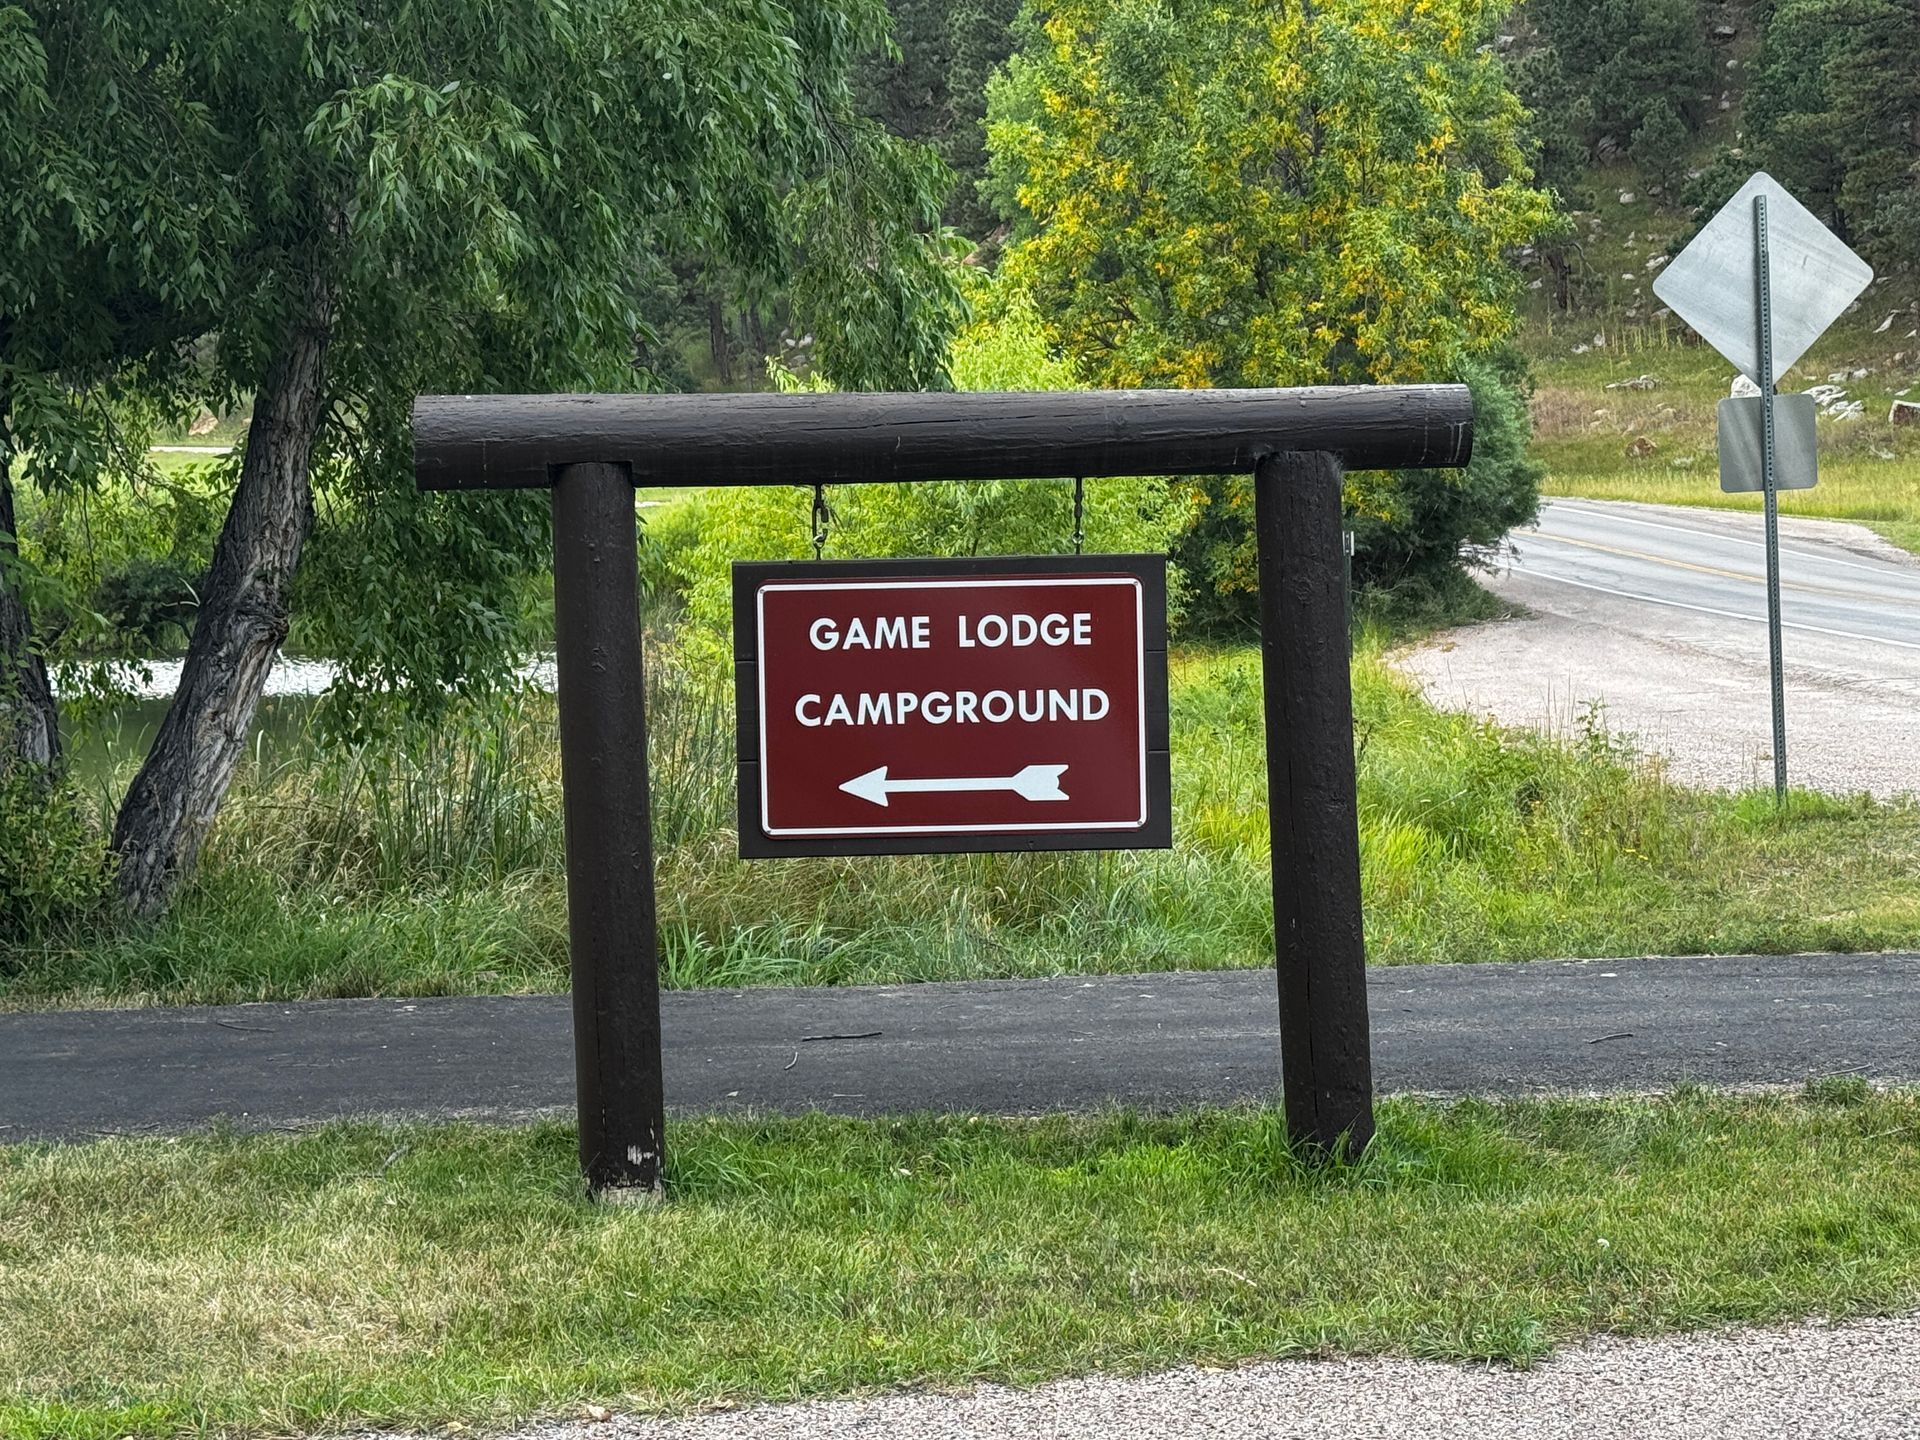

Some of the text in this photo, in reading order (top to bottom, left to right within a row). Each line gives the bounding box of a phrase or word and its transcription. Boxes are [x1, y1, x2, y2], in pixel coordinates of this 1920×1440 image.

[809, 612, 1092, 651] GAME LODGE
[795, 688, 1110, 727] CAMPGROUND
